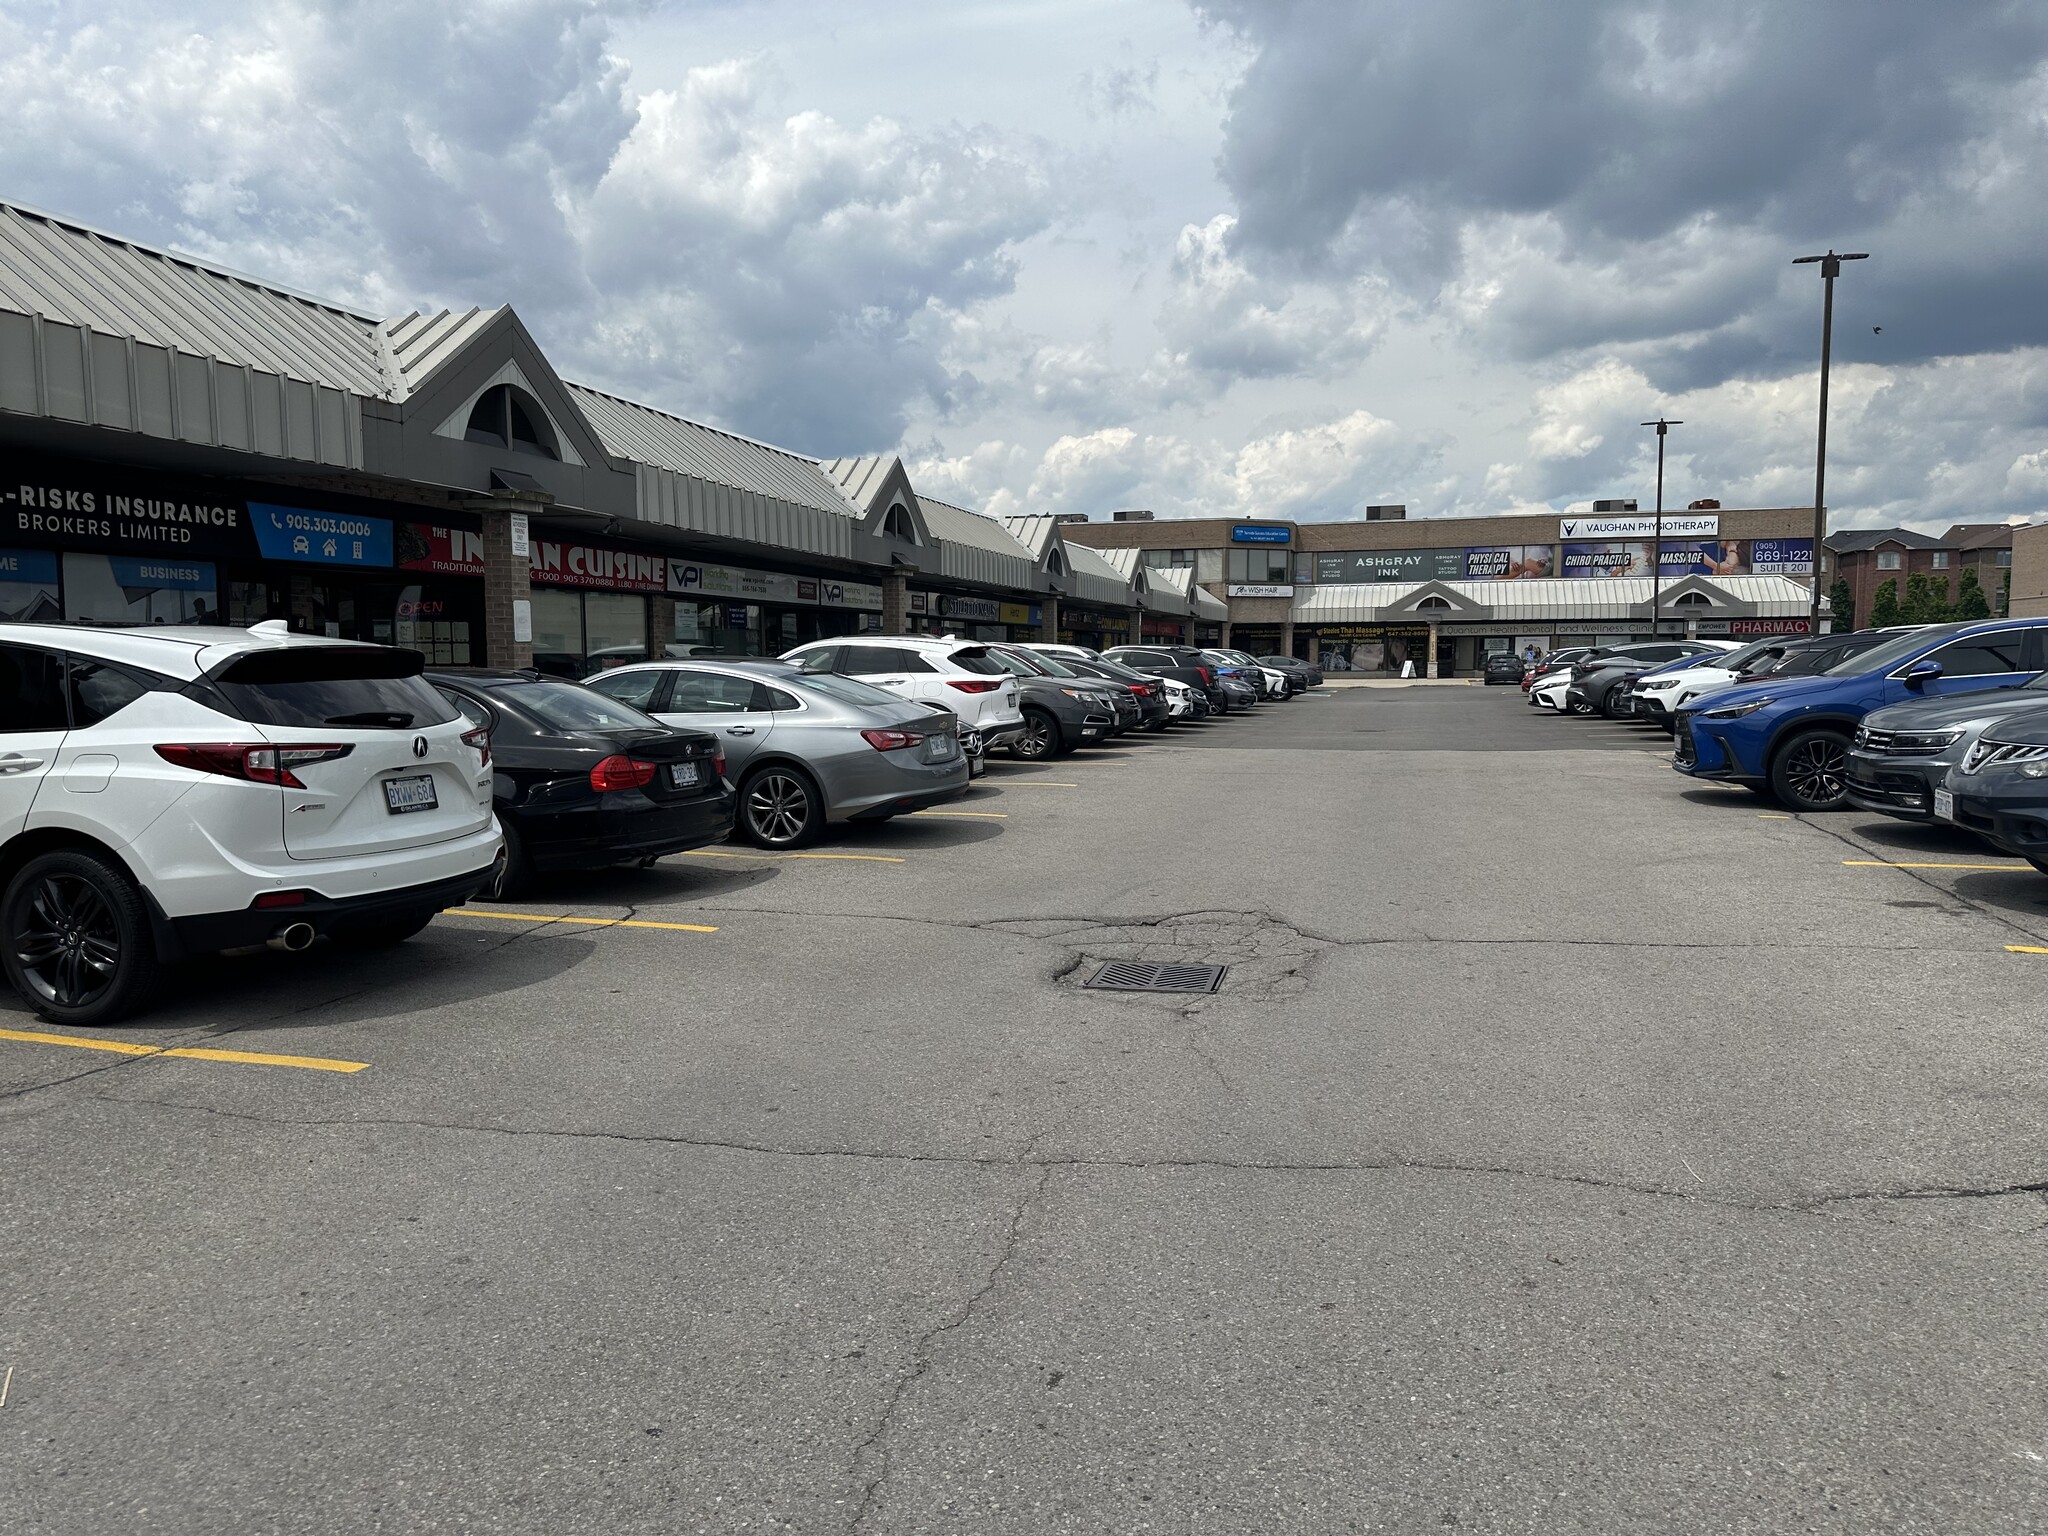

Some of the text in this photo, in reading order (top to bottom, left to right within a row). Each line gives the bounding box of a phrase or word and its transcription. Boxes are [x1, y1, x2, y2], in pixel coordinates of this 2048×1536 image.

[0, 486, 238, 527] -RISKS INSURANCE
[18, 513, 191, 542] BROKERS LIMITED
[286, 514, 371, 536] 905.303.0006
[1586, 521, 1716, 532] VAUGHAN PHYSIOTHERAPY
[432, 527, 447, 538] THE
[1756, 542, 1777, 550] (905)
[1356, 556, 1422, 567] ASHGRAY
[1468, 553, 1509, 564] PHYSICAL
[1565, 554, 1630, 566] CHIROPRACTIC
[1659, 552, 1703, 564] MASSAGE
[1756, 550, 1812, 562] 669-1221
[432, 560, 485, 573] TRADITIONA
[568, 546, 664, 583] CUISINE
[1468, 564, 1507, 575] THERAPY
[1760, 563, 1807, 572] SUITE 201
[140, 566, 199, 581] BUSINESS
[671, 564, 702, 588] VPI
[703, 568, 728, 580] working
[1378, 568, 1399, 576] INK
[538, 571, 560, 581] FOOD
[563, 574, 578, 583] 905
[595, 578, 614, 587] 0880
[647, 583, 664, 592] DINING
[703, 580, 733, 592] solutions
[823, 584, 843, 603] VPI
[399, 601, 444, 616] OPEN
[1447, 626, 1486, 634] Quantum
[1490, 625, 1518, 633] Health
[1582, 624, 1623, 632] Wellness
[1628, 624, 1654, 632] Clinic
[1732, 622, 1811, 632] PHARMACY
